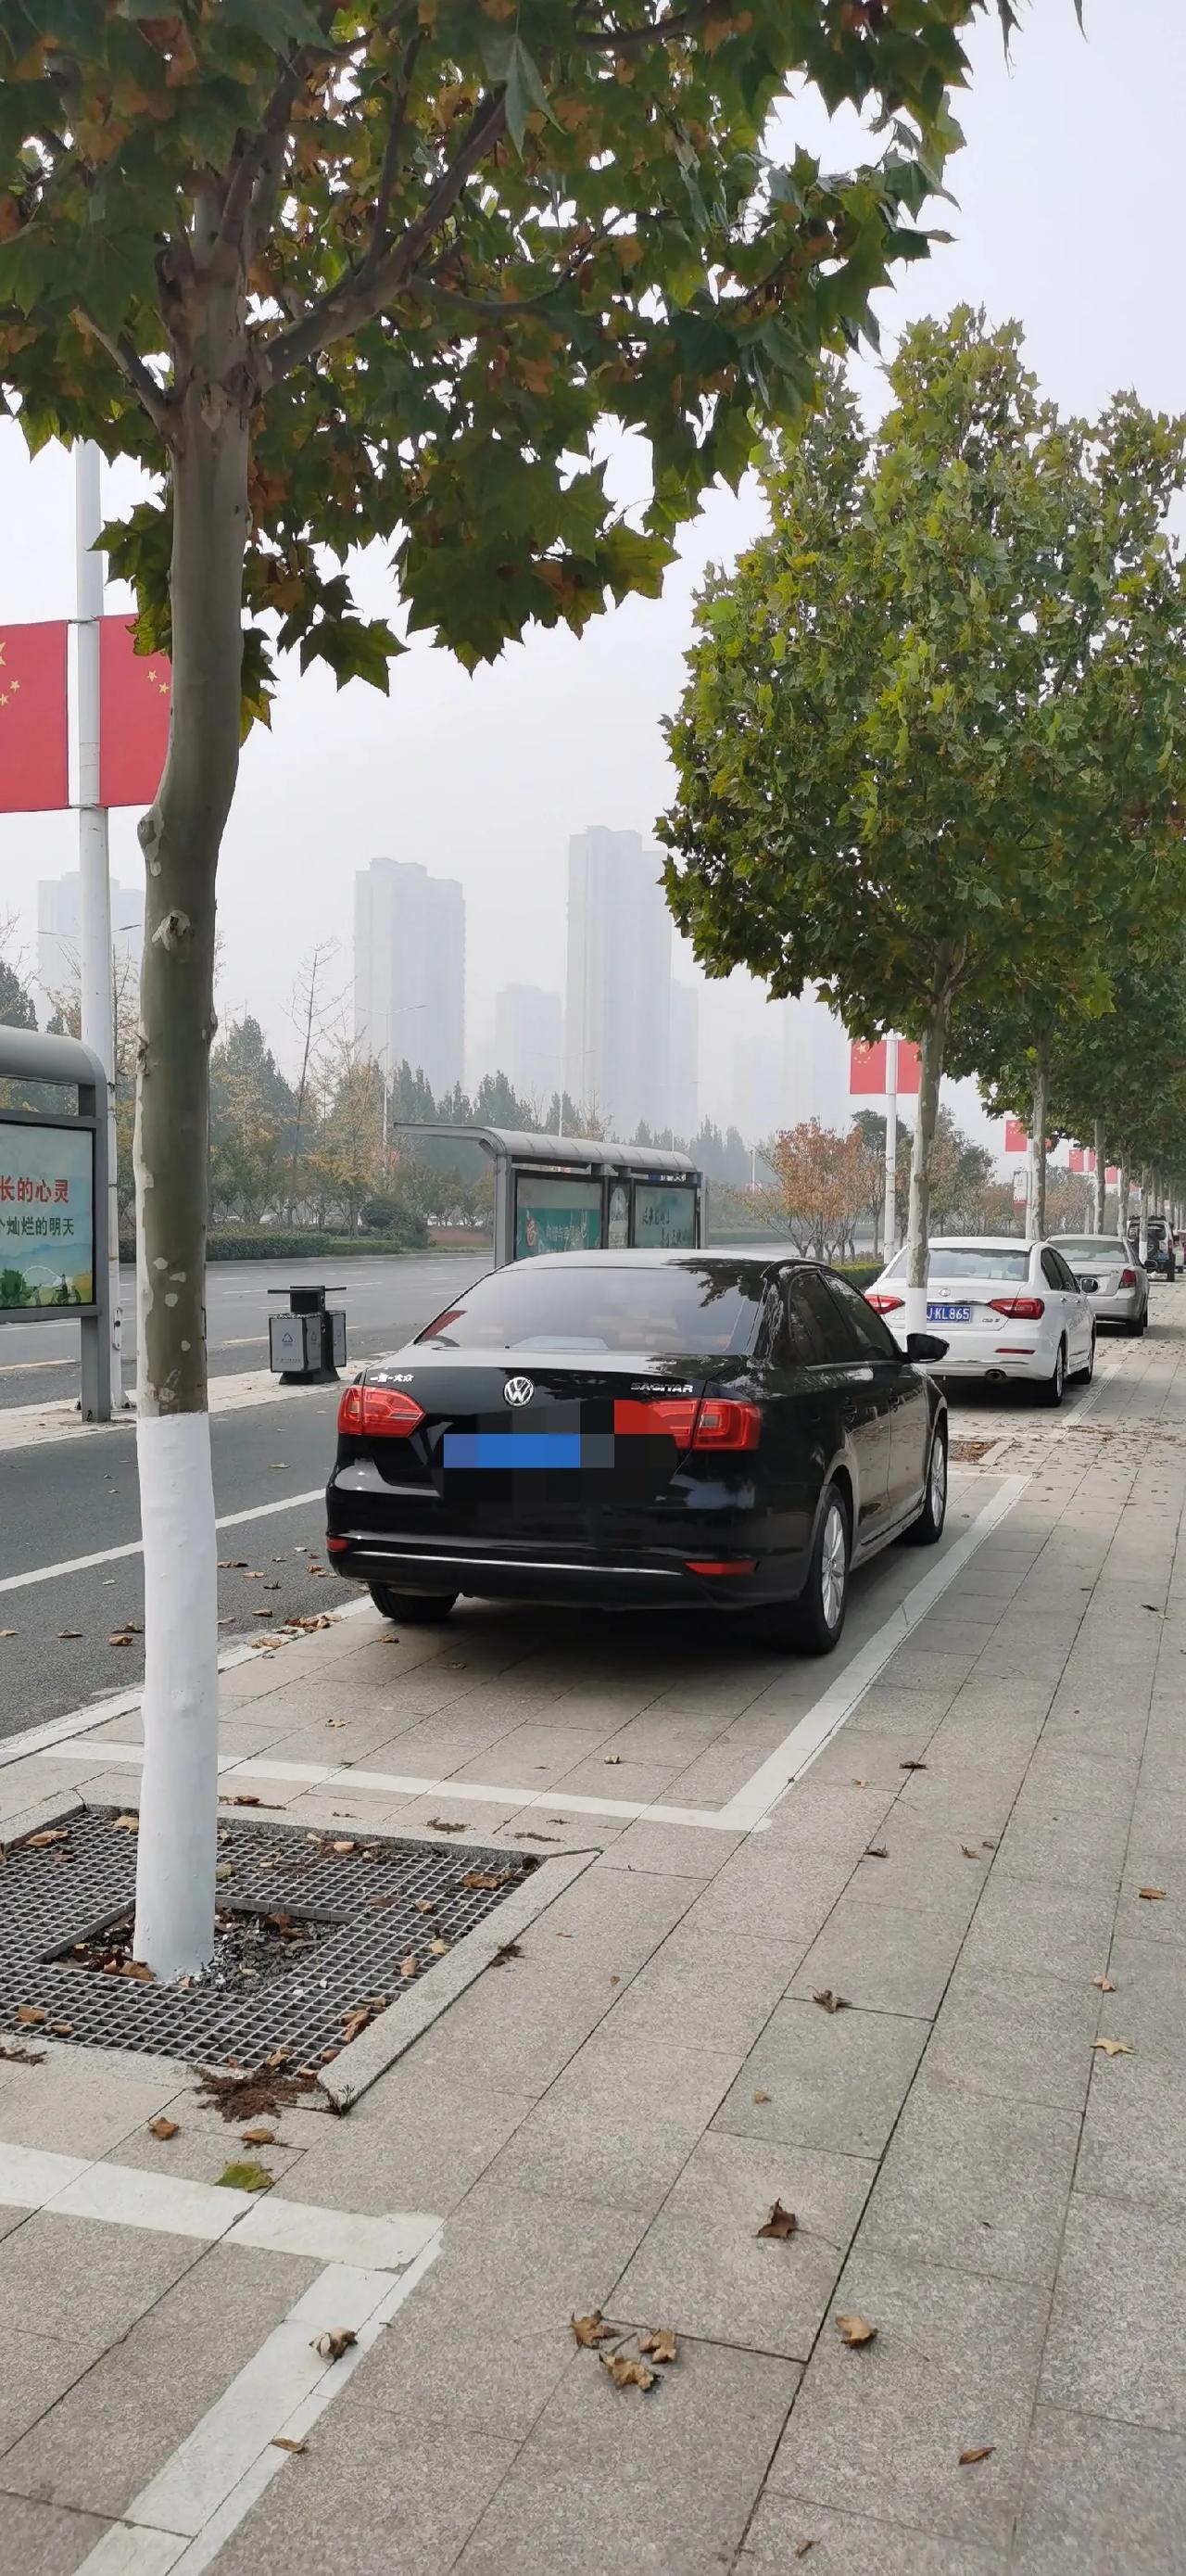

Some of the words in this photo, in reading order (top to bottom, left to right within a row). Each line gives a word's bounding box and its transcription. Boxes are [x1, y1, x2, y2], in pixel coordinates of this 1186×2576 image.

[0, 1175, 69, 1203] 长的心灵
[630, 1382, 694, 1393] SAGITAR
